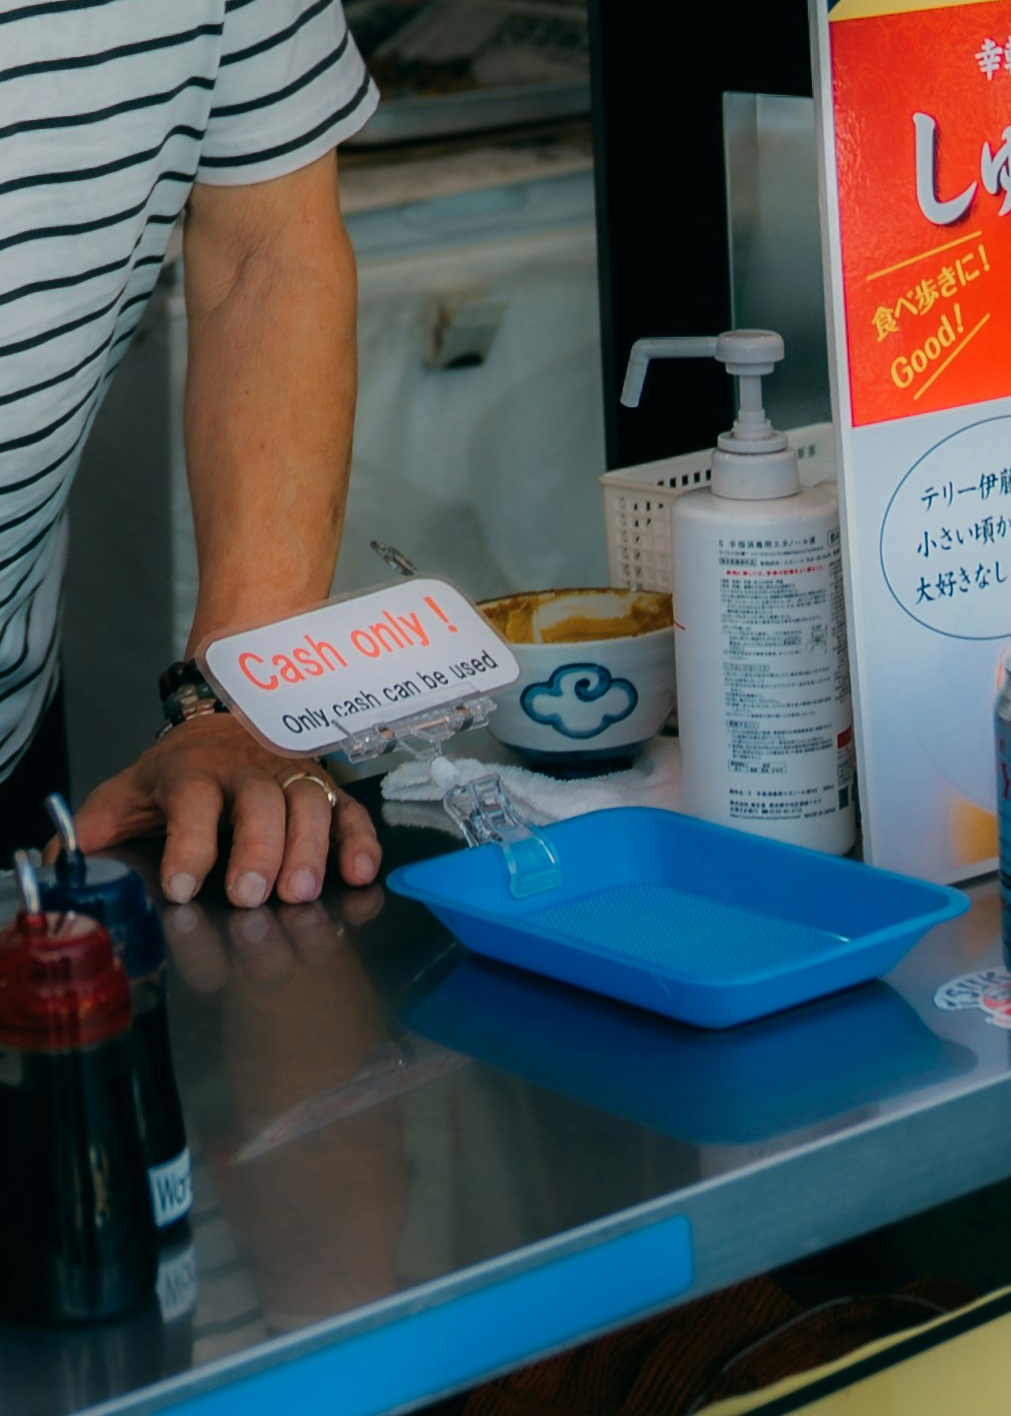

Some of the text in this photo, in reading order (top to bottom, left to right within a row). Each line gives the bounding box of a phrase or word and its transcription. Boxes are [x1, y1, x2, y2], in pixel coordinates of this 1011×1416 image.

[890, 303, 967, 390] Good!
[915, 560, 1009, 606] 大好きなし
[238, 634, 349, 692] Cash
[281, 649, 500, 735] Only cash can be used
